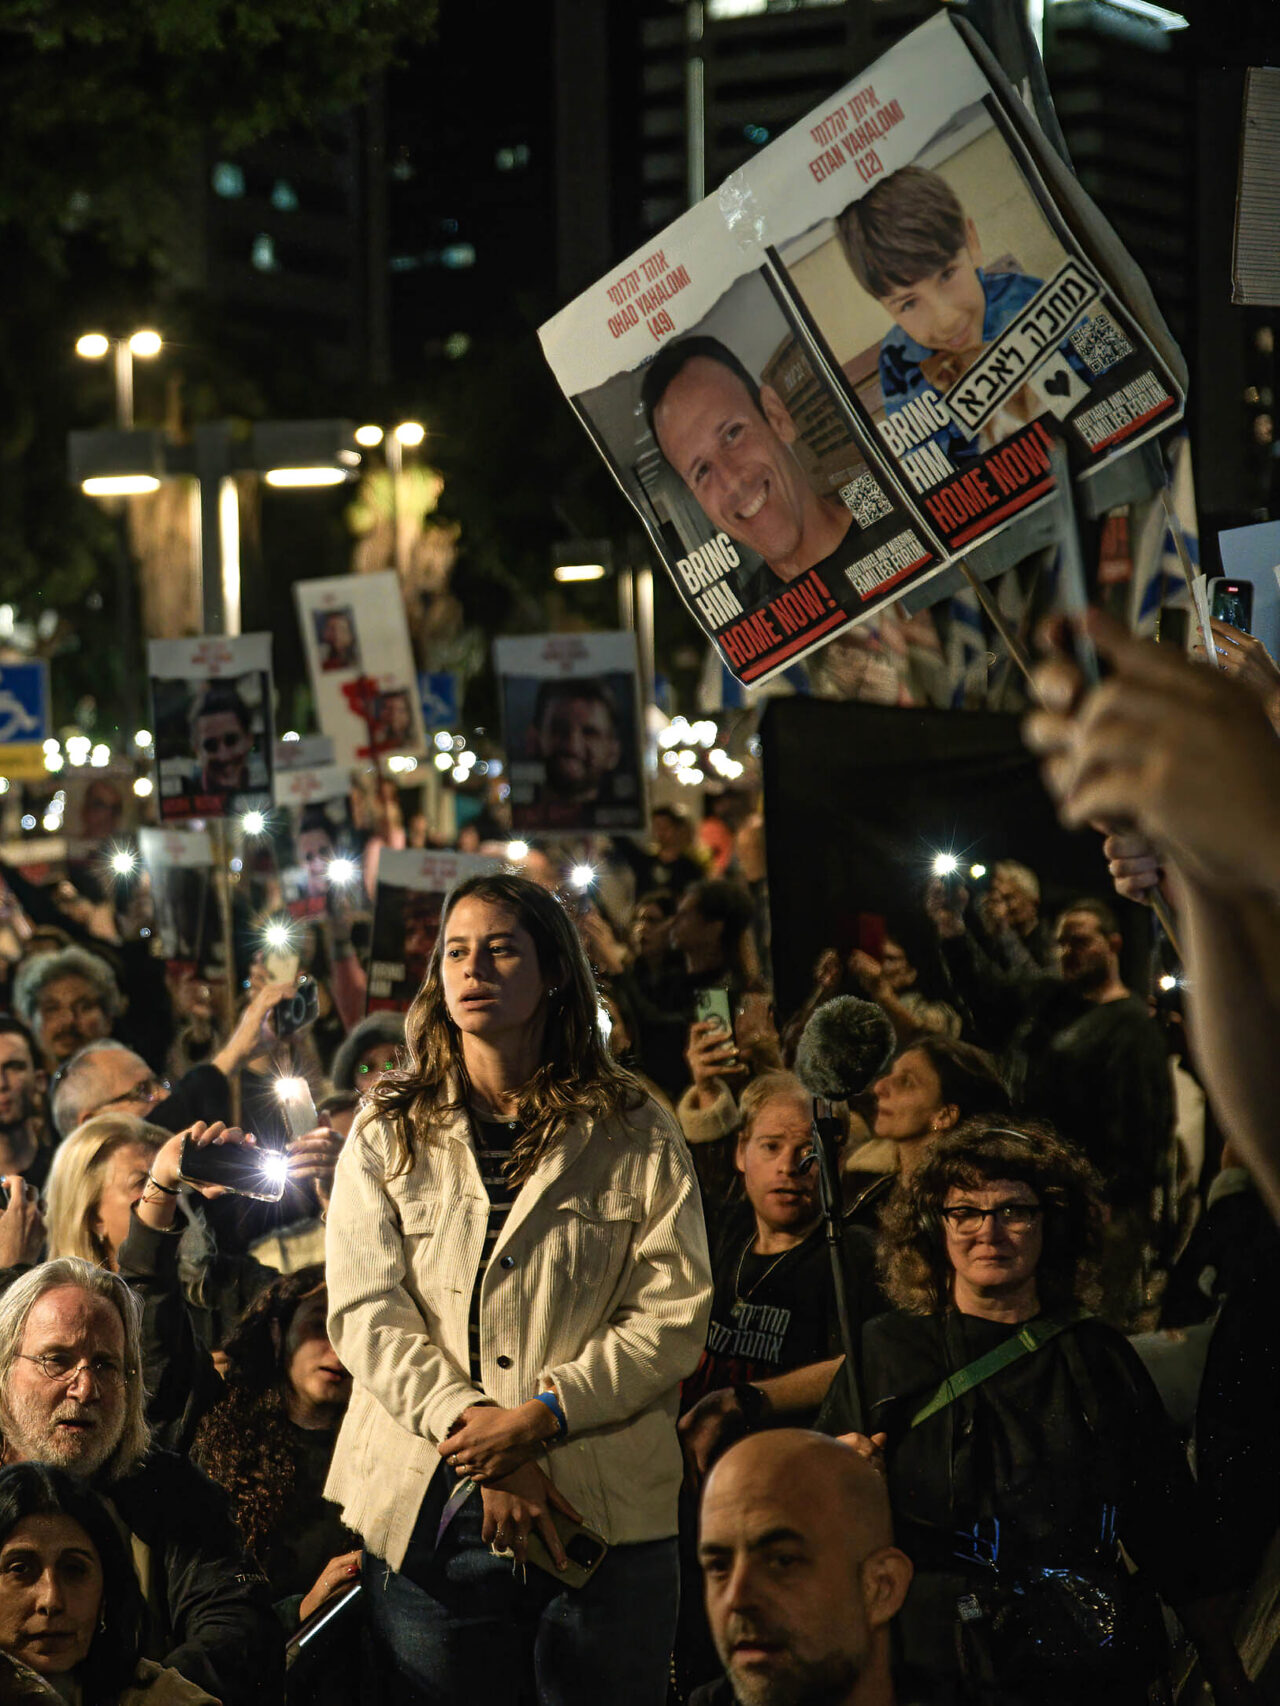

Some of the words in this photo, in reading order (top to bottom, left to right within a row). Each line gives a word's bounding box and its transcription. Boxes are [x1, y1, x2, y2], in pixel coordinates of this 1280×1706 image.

[810, 106, 849, 148] יהלומי
[847, 85, 880, 124] איתן
[809, 144, 846, 183] EITAN
[841, 99, 905, 157] YAHALOMI
[854, 148, 884, 184] (12)
[606, 269, 641, 306] יהלומי
[639, 249, 670, 282] אוהד
[608, 304, 639, 339] OHAD
[635, 264, 691, 317] YAHALOMI
[646, 308, 676, 342] (49)
[1020, 277, 1087, 349] מחכה
[957, 344, 1026, 417] לאבא
[877, 390, 951, 458] BRING
[1081, 404, 1133, 447] FAMILIES
[900, 439, 956, 495] HIM
[924, 467, 1000, 534] HOME
[676, 532, 741, 595] BRING
[852, 558, 896, 596] FAMILIES
[890, 539, 927, 572] FORUM
[696, 580, 744, 630] HIM
[719, 608, 784, 668] HOME
[768, 569, 837, 636] NOW!
